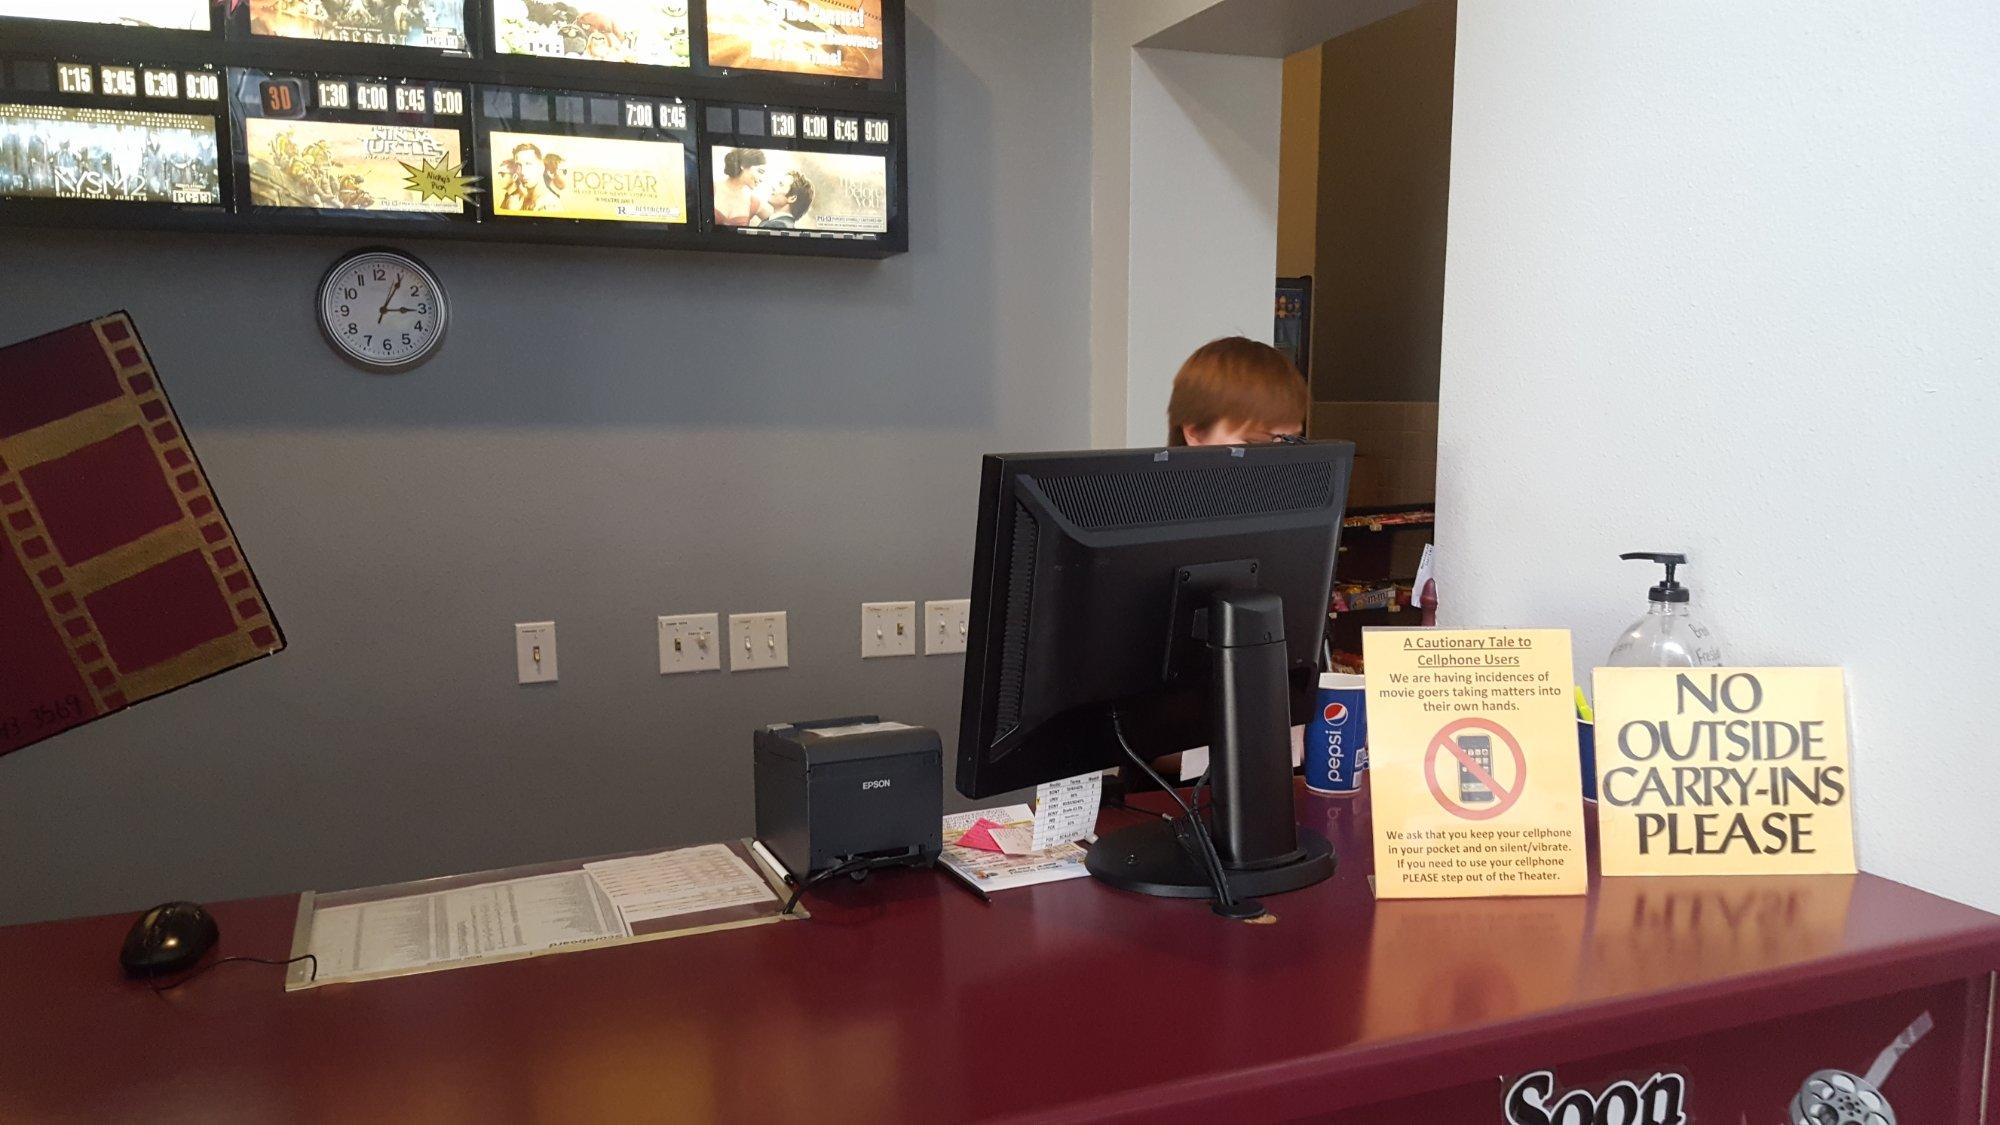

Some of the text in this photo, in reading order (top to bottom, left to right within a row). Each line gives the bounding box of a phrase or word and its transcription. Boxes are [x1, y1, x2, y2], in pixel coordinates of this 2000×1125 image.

[60, 67, 91, 92] 1:15
[268, 86, 292, 110] 3D
[319, 84, 463, 114] 1:30 4:00 6:45 9:00
[626, 104, 652, 127] 7:00
[772, 115, 889, 142] 1:30 4:00 6:45 9:00
[573, 171, 657, 192] POPSTAR
[617, 206, 626, 214] R
[357, 275, 365, 286] 11
[373, 269, 386, 281] 12
[345, 288, 357, 299] 10
[410, 285, 419, 297] 2
[340, 305, 350, 316] 9
[417, 303, 427, 314] 3
[348, 323, 358, 334] 8
[414, 321, 423, 332] 4
[364, 335, 373, 346] 7
[383, 339, 392, 350] 6
[402, 334, 411, 345] 5
[1404, 636, 1532, 649] A Cautionary Tale to
[1418, 654, 1519, 667] Cellphone Users
[1390, 673, 1409, 683] We
[1434, 672, 1472, 684] having
[1475, 672, 1534, 682] incidences
[1538, 671, 1549, 681] of
[1380, 686, 1561, 699] movie goers taking matters into
[1676, 672, 1763, 715] NO
[1424, 701, 1519, 711] their own hands.
[1617, 719, 1827, 762] OUTSIDE
[1325, 730, 1344, 782] pepsi
[862, 779, 890, 790] EPSON
[1602, 765, 1845, 807] CARRY-INS
[1386, 829, 1571, 841] We ask that you keep your cellphone
[1634, 812, 1817, 856] PLEASE
[1389, 845, 1397, 854] in
[1401, 846, 1423, 855] your
[1427, 844, 1460, 855] pocket
[1463, 844, 1481, 853] and
[1500, 843, 1571, 853] silent/vibrate.
[1397, 858, 1564, 869] If you need to use your cellphone
[1403, 872, 1560, 883] PLEASE step out of the Theater.
